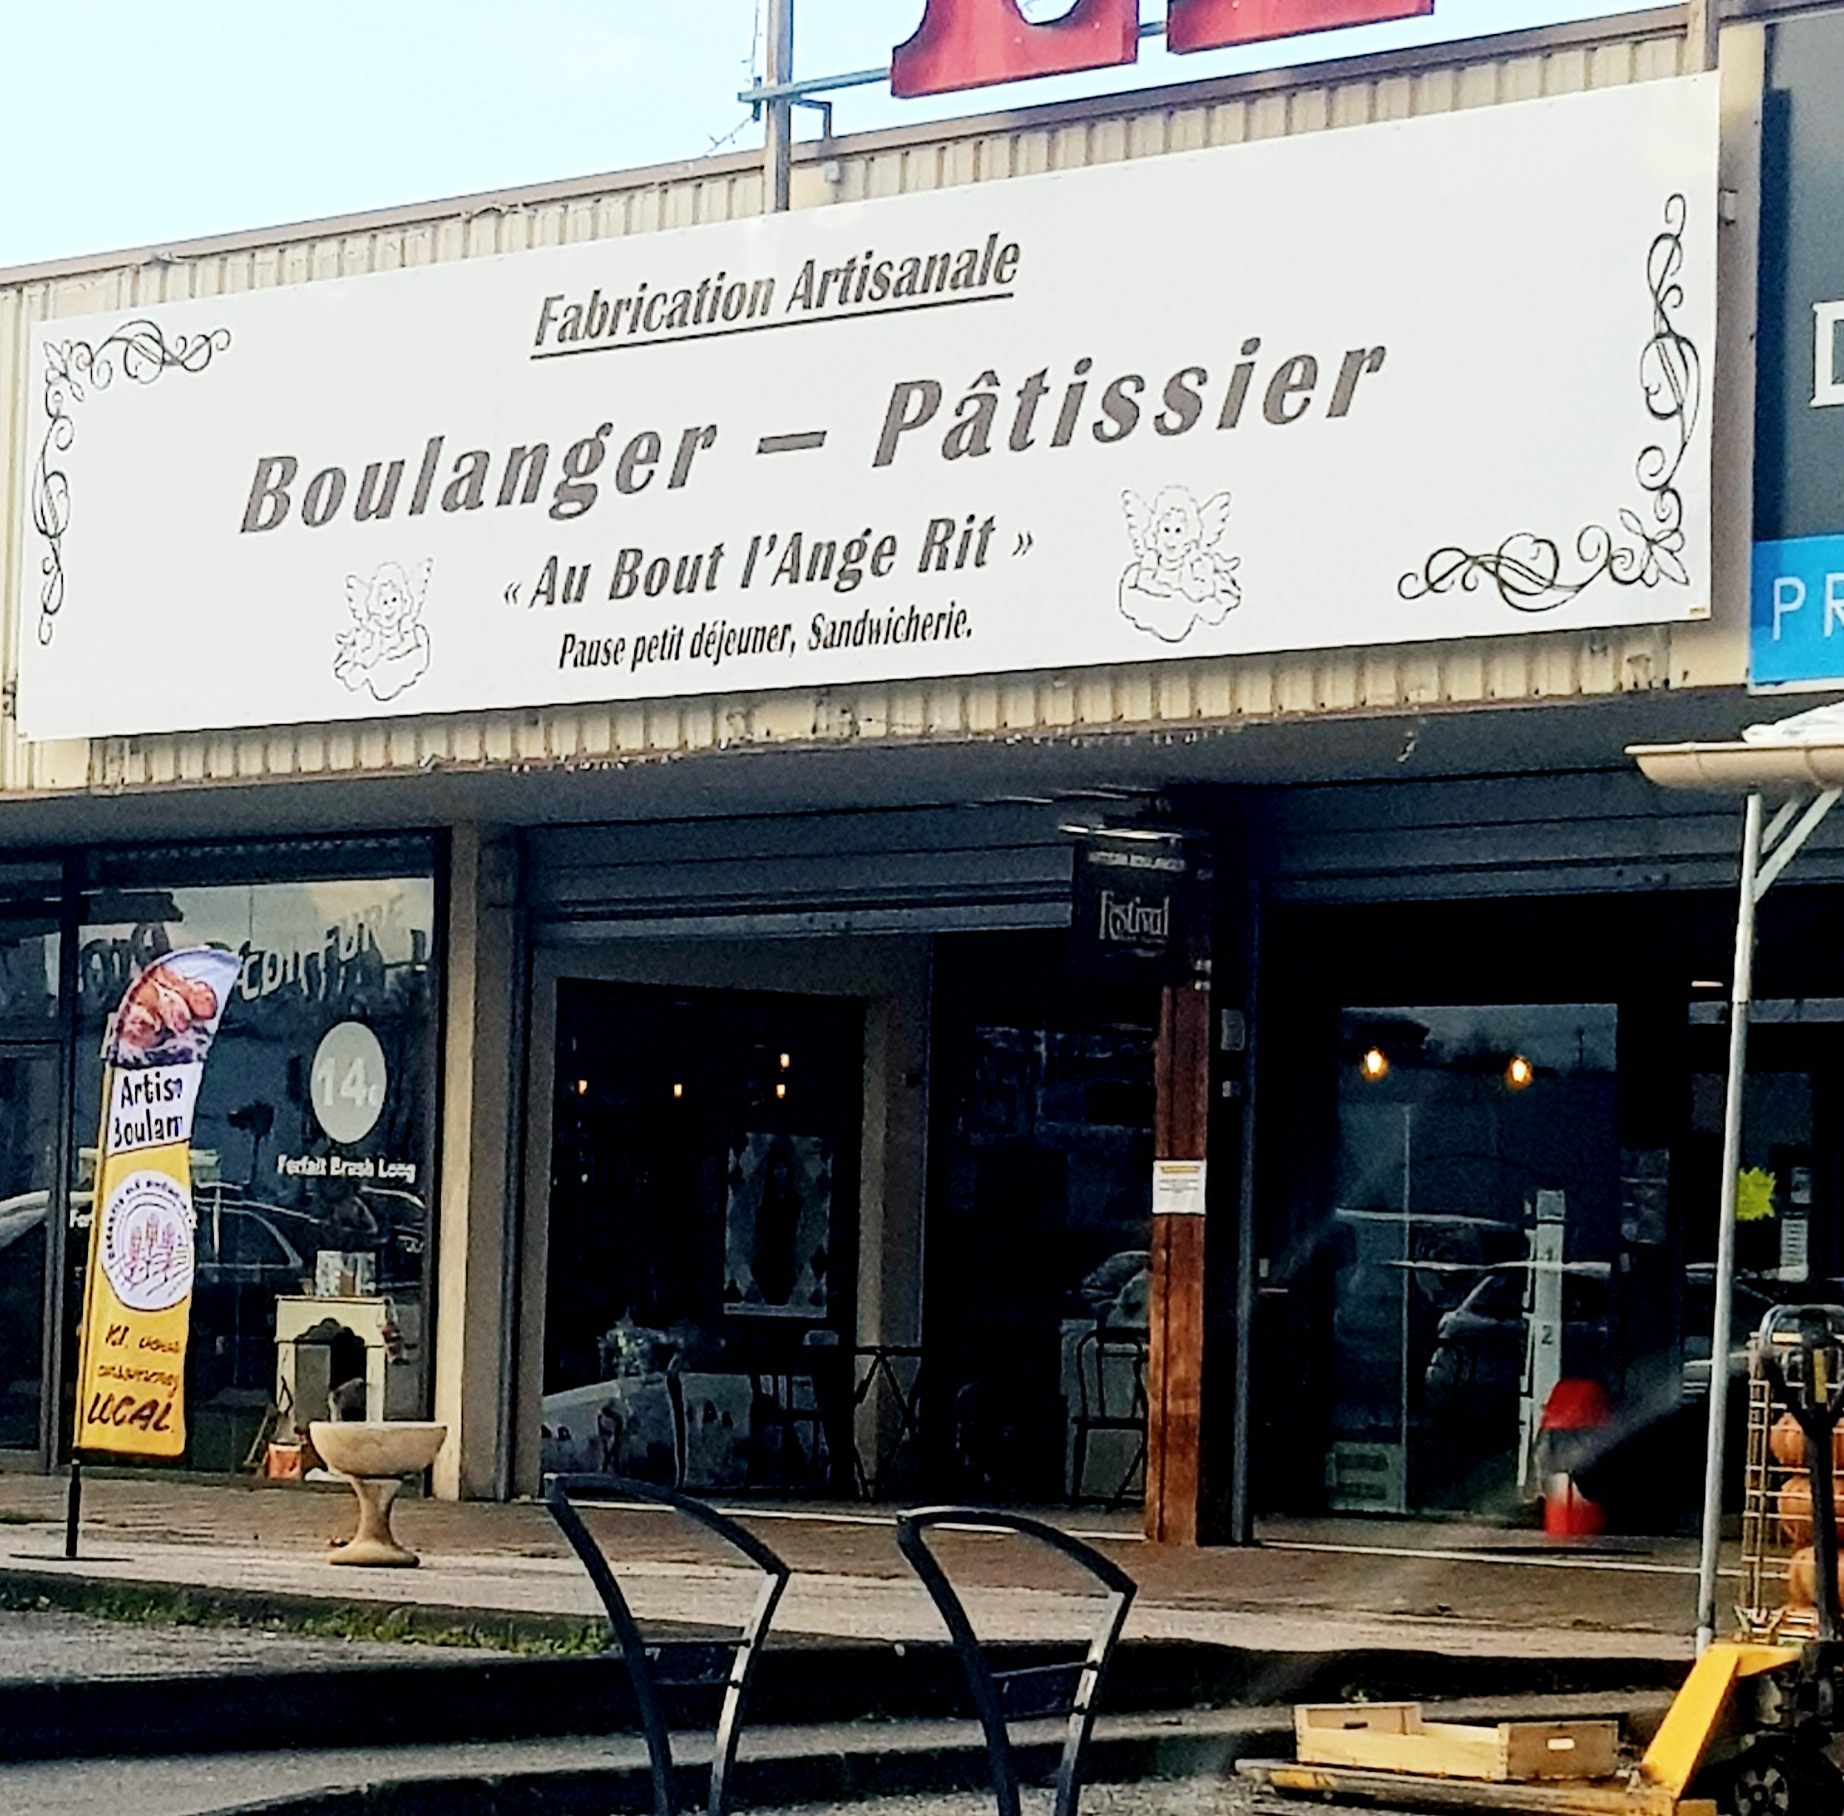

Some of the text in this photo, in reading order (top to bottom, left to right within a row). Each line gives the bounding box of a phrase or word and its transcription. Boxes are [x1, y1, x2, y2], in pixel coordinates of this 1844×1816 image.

[534, 232, 1020, 347] Fabrication Artisanale
[240, 422, 718, 534] Boulanger
[871, 336, 1387, 468] Pâtissier
[528, 554, 592, 609] Au
[608, 540, 726, 602] Bout
[740, 527, 897, 594] l'Ange
[917, 513, 997, 574] Rit
[558, 600, 973, 673] Pause petit déjeuner, Sandwicherie.
